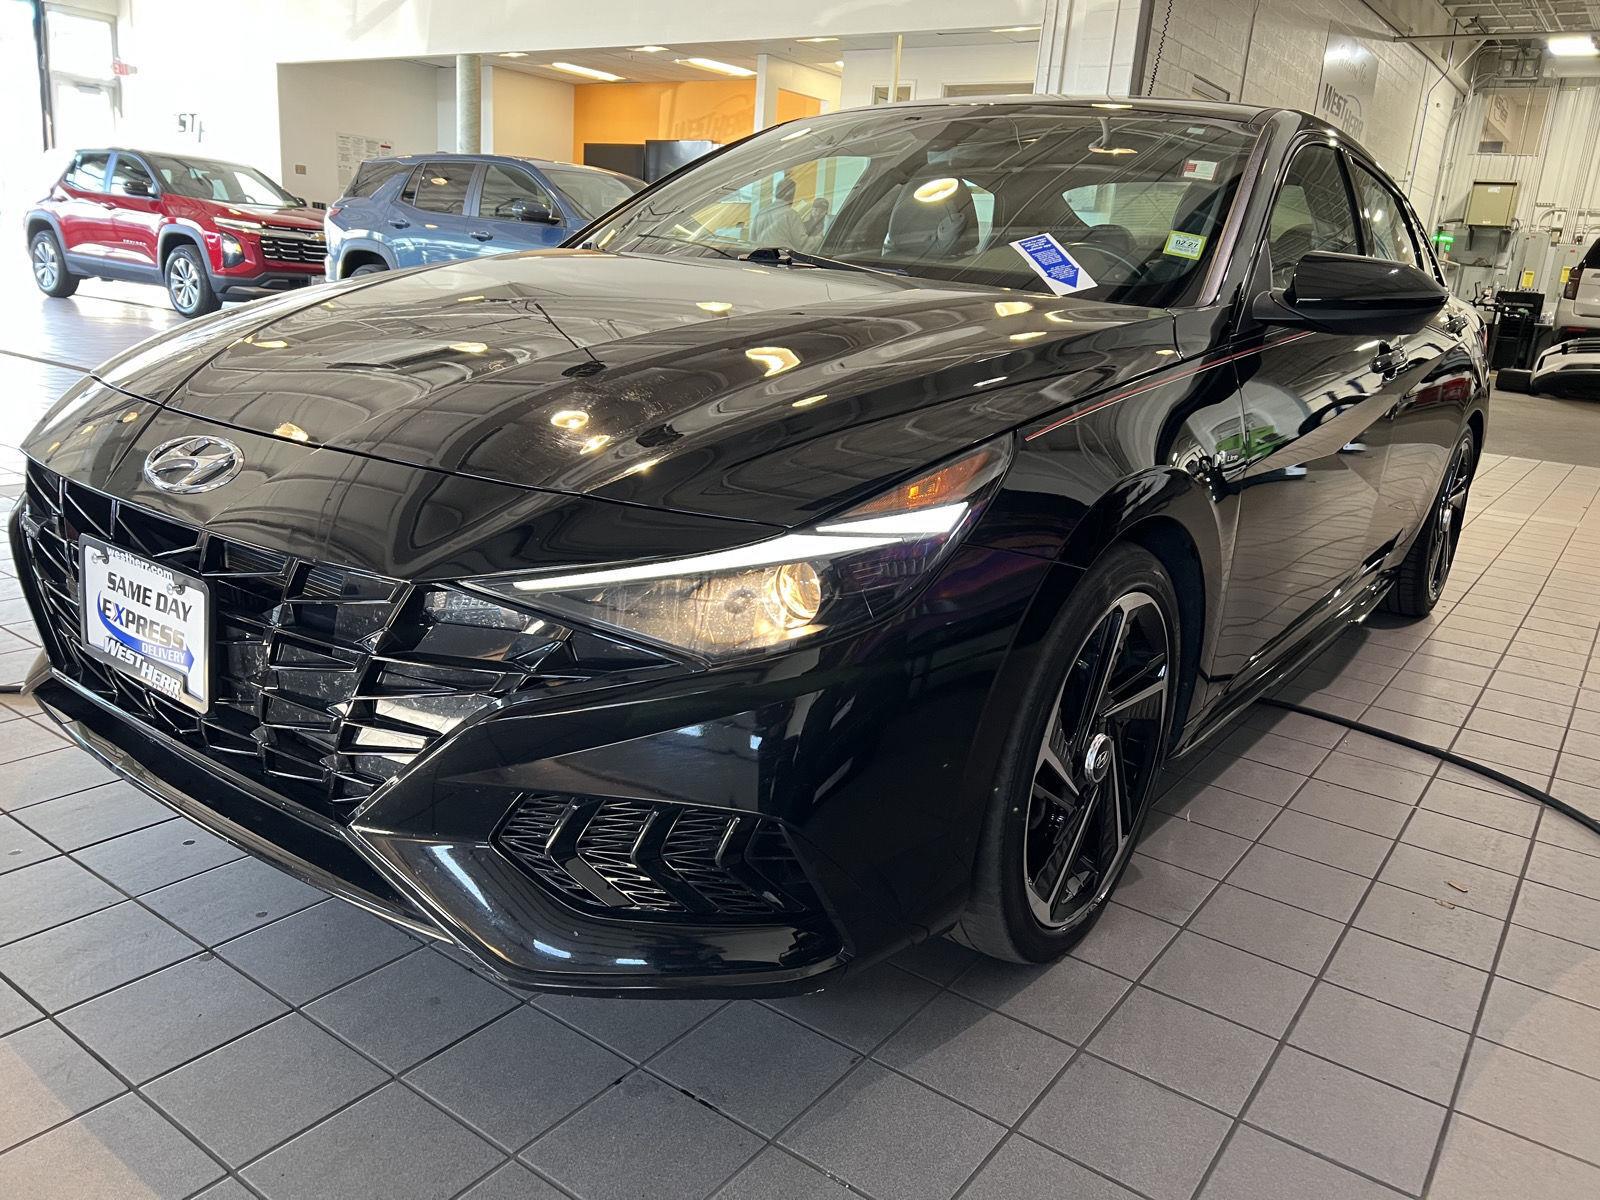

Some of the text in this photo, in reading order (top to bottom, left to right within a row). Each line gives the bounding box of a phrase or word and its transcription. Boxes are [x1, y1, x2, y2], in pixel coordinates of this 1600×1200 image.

[1322, 83, 1348, 119] WEST
[106, 547, 173, 580] westherr.com
[107, 571, 193, 623] SAME DAY
[102, 597, 185, 650] EXPRESS
[103, 635, 145, 668] WEST
[140, 660, 182, 693] HERR
[141, 642, 186, 664] DELIVERY
